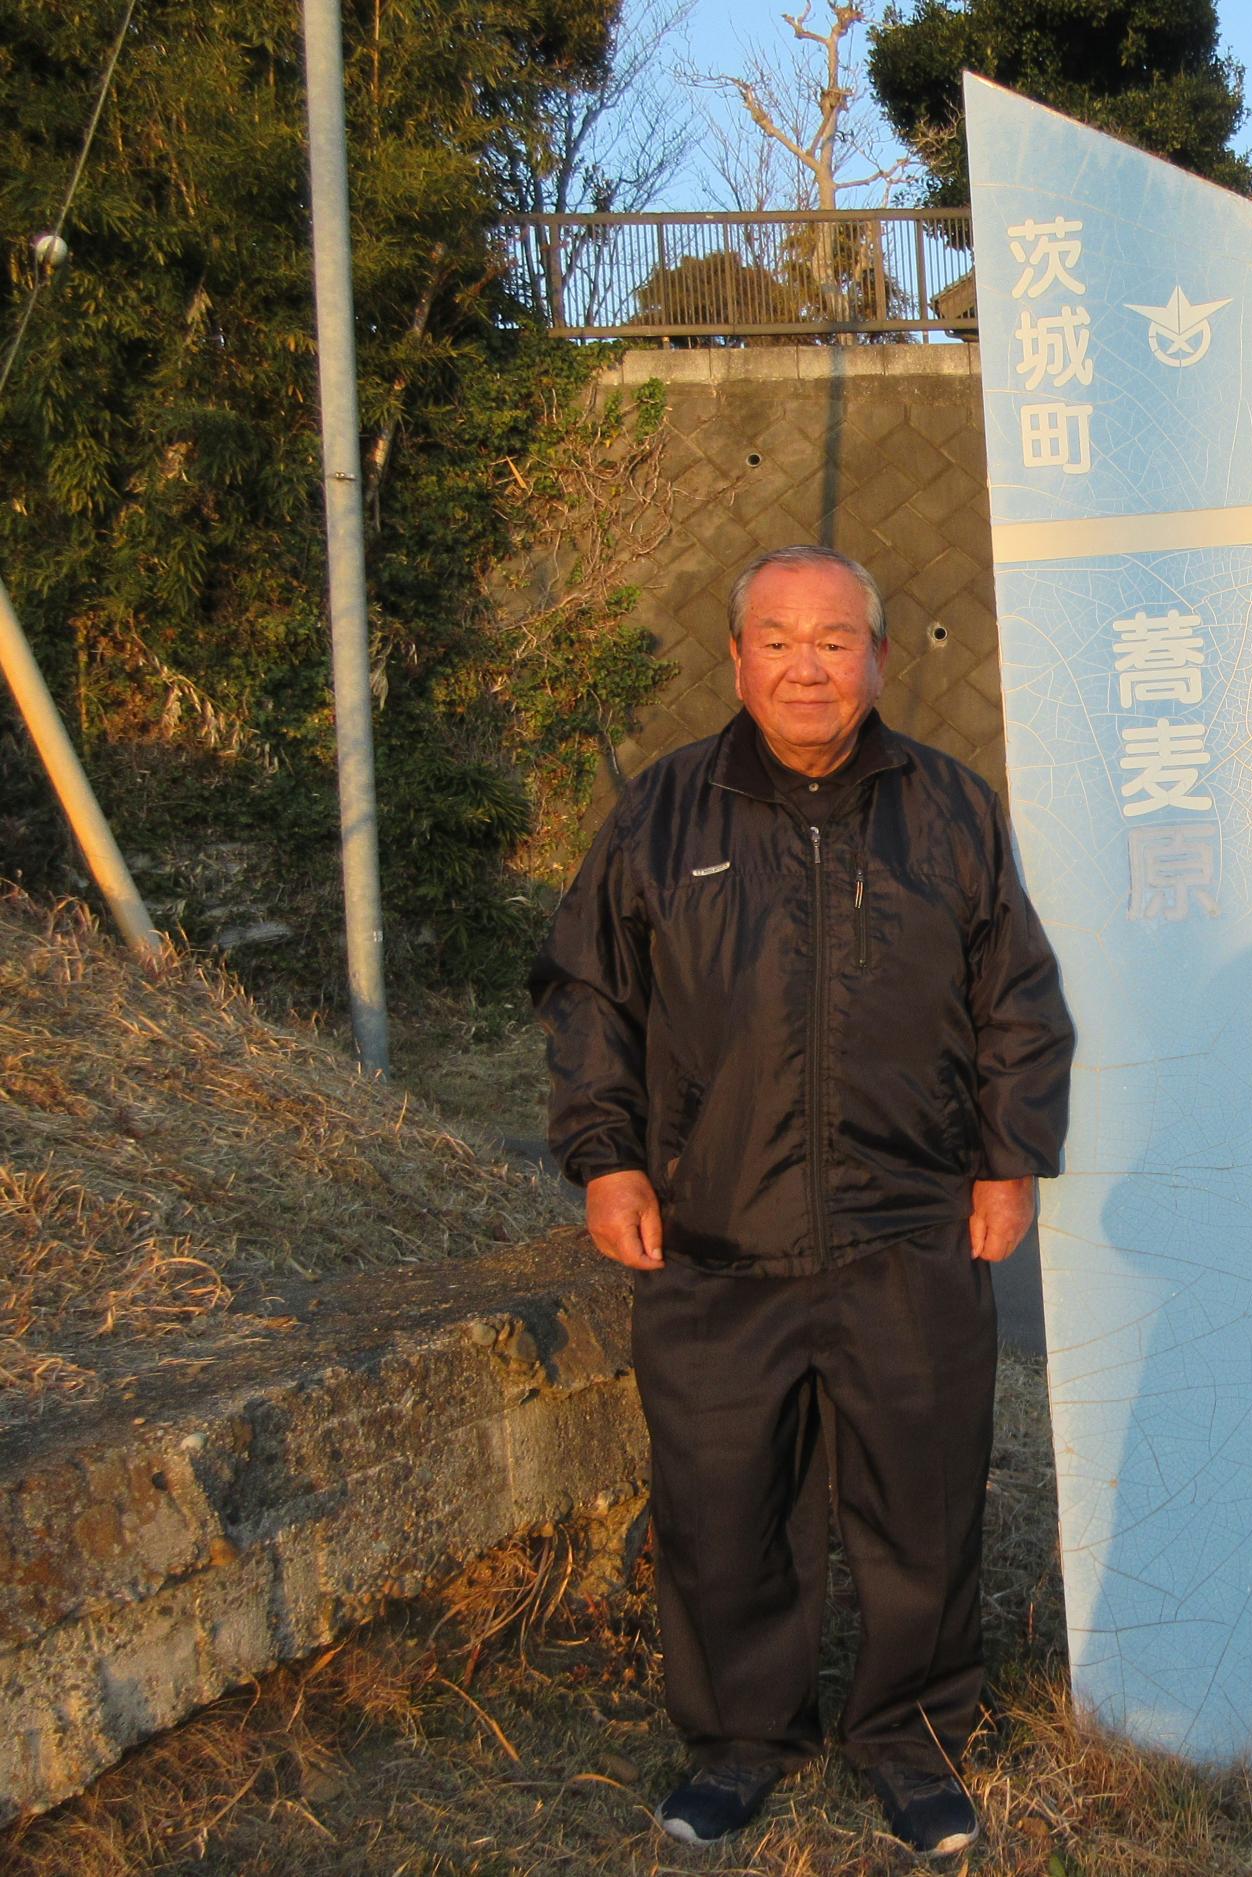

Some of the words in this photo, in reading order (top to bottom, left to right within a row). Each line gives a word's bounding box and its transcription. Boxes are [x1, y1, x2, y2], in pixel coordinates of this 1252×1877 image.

[1007, 215, 1094, 475] 茨城町
[1112, 608, 1213, 922] 蕎麦原
